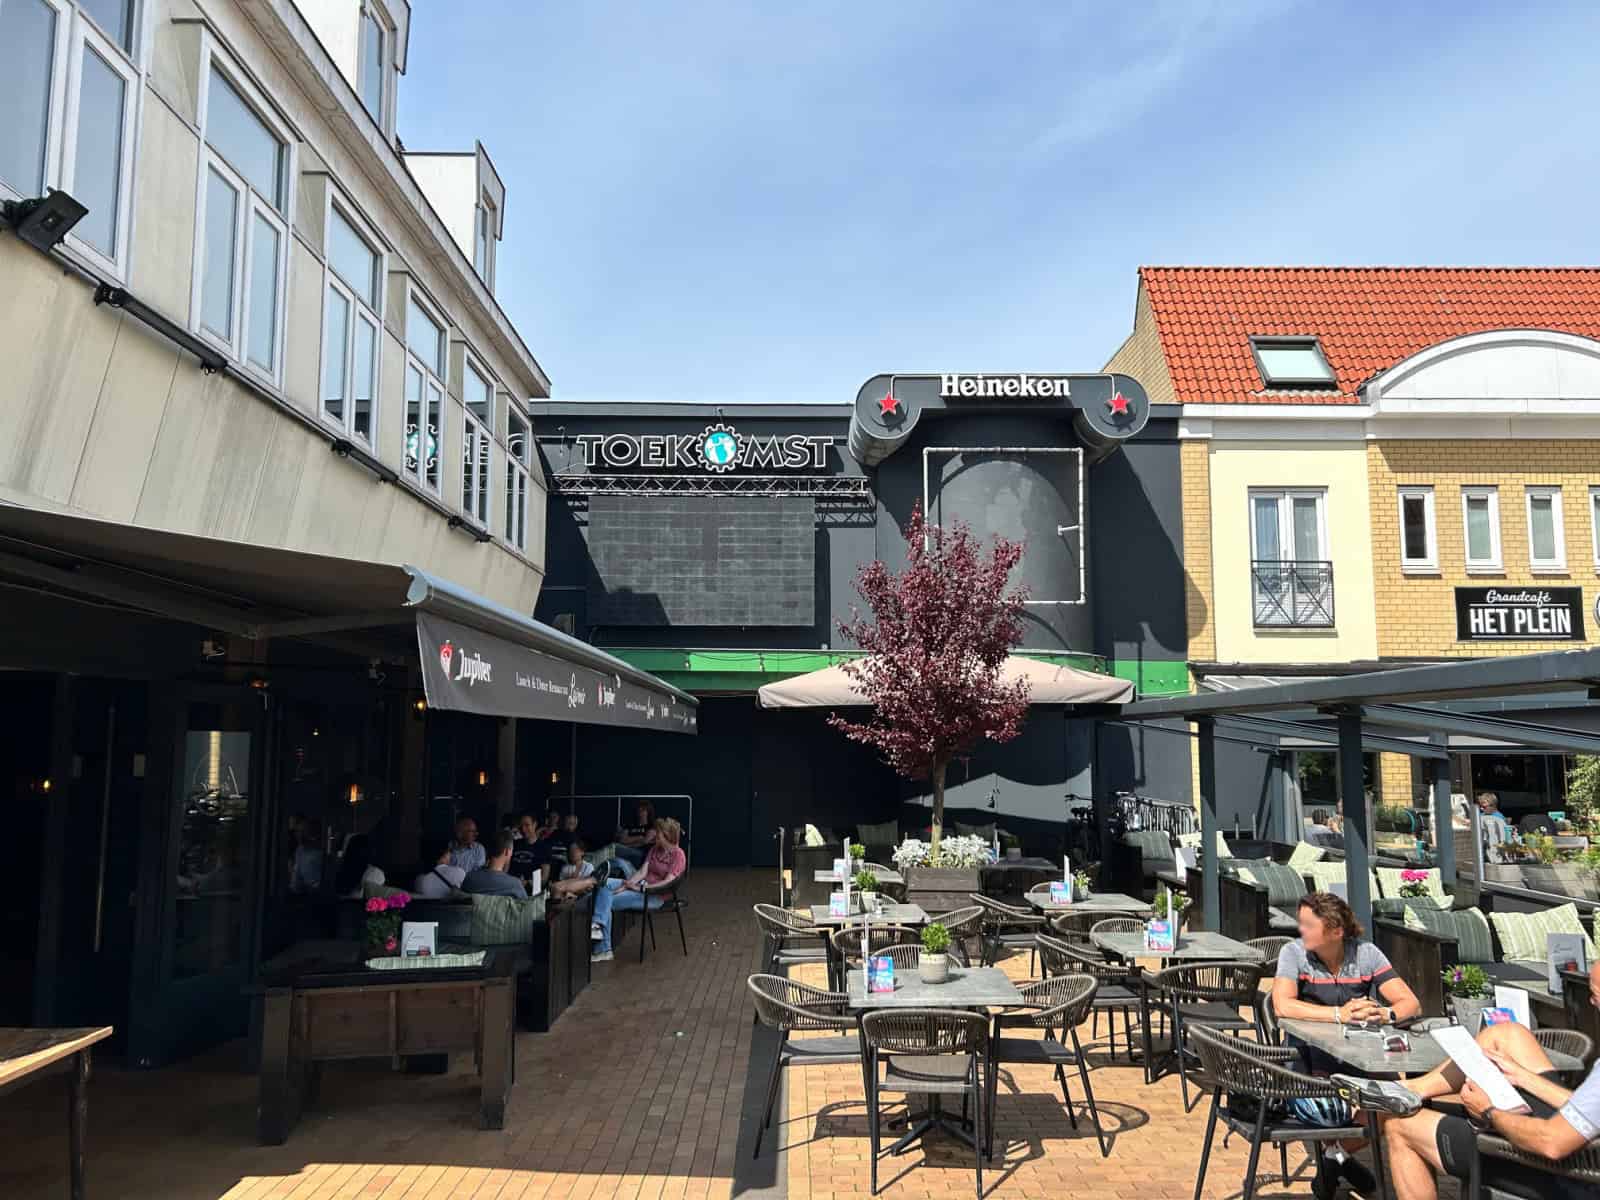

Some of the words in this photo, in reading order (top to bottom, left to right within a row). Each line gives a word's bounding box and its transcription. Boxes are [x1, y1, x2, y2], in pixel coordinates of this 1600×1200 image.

[940, 373, 1071, 397] Heineken
[1485, 589, 1552, 607] Grandcafé
[1469, 607, 1509, 634] HET
[1513, 607, 1572, 634] PLEIN
